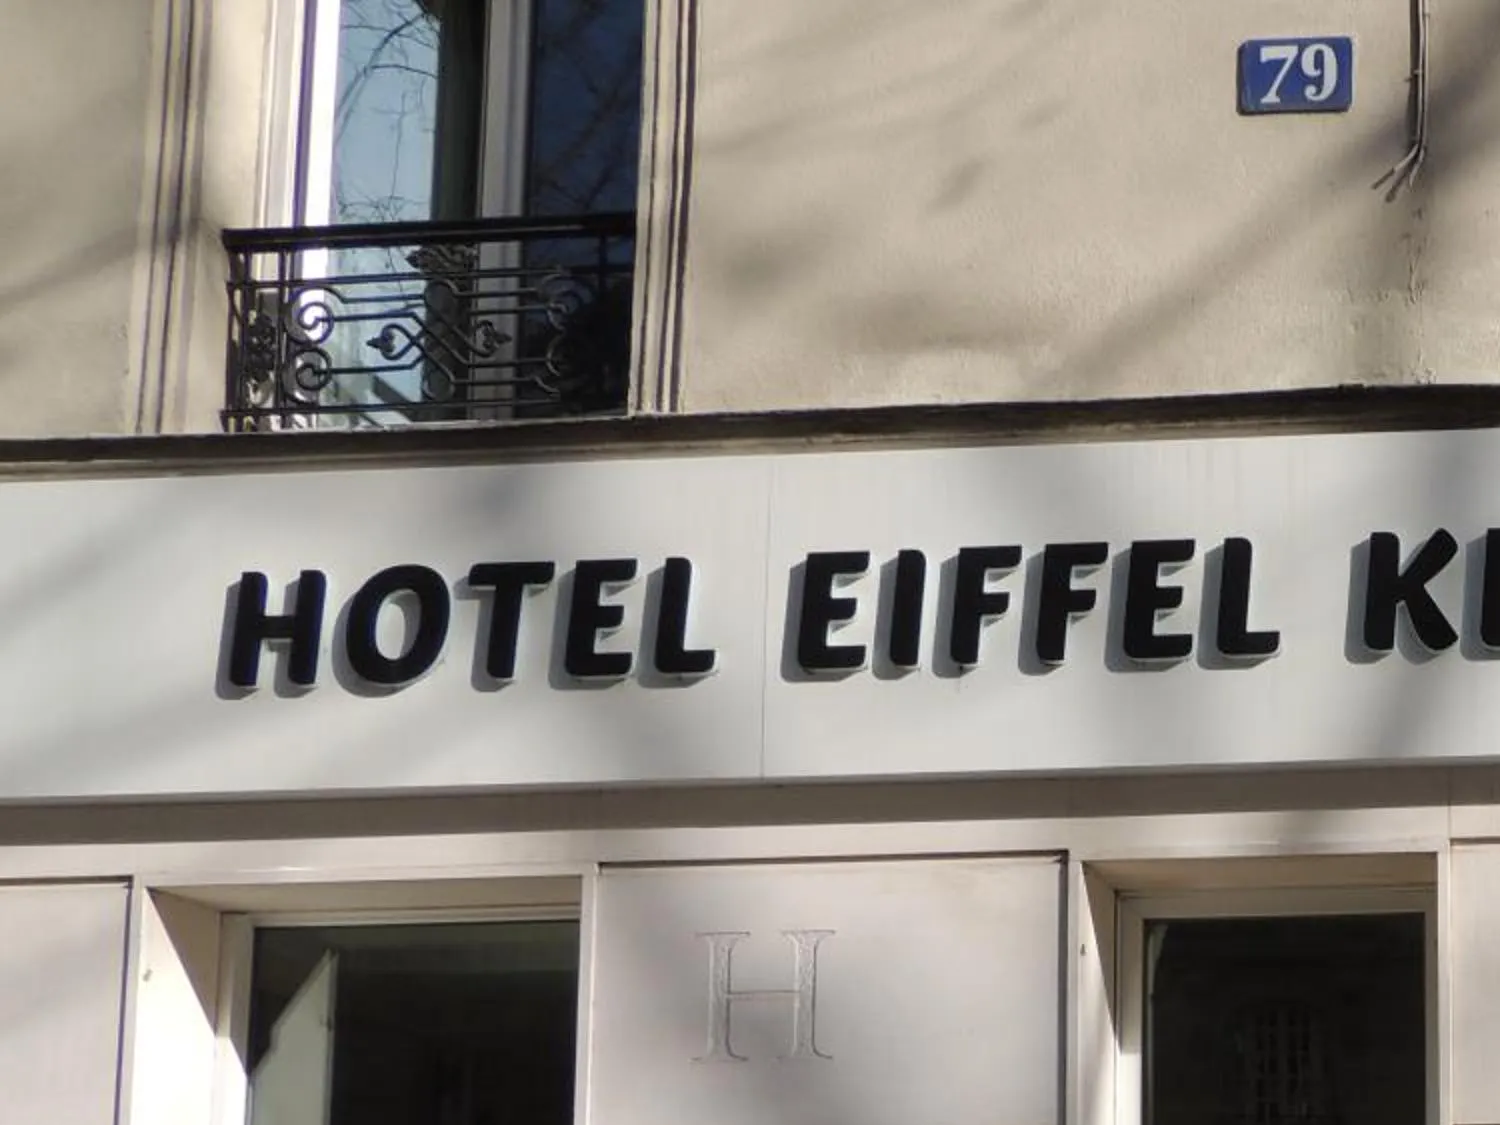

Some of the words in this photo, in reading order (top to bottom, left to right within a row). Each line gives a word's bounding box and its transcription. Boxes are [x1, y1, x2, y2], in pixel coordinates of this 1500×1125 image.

[1260, 44, 1338, 104] 79
[227, 557, 716, 690] HOTEL
[795, 538, 1282, 677] EIFFEL
[690, 929, 836, 1062] H
